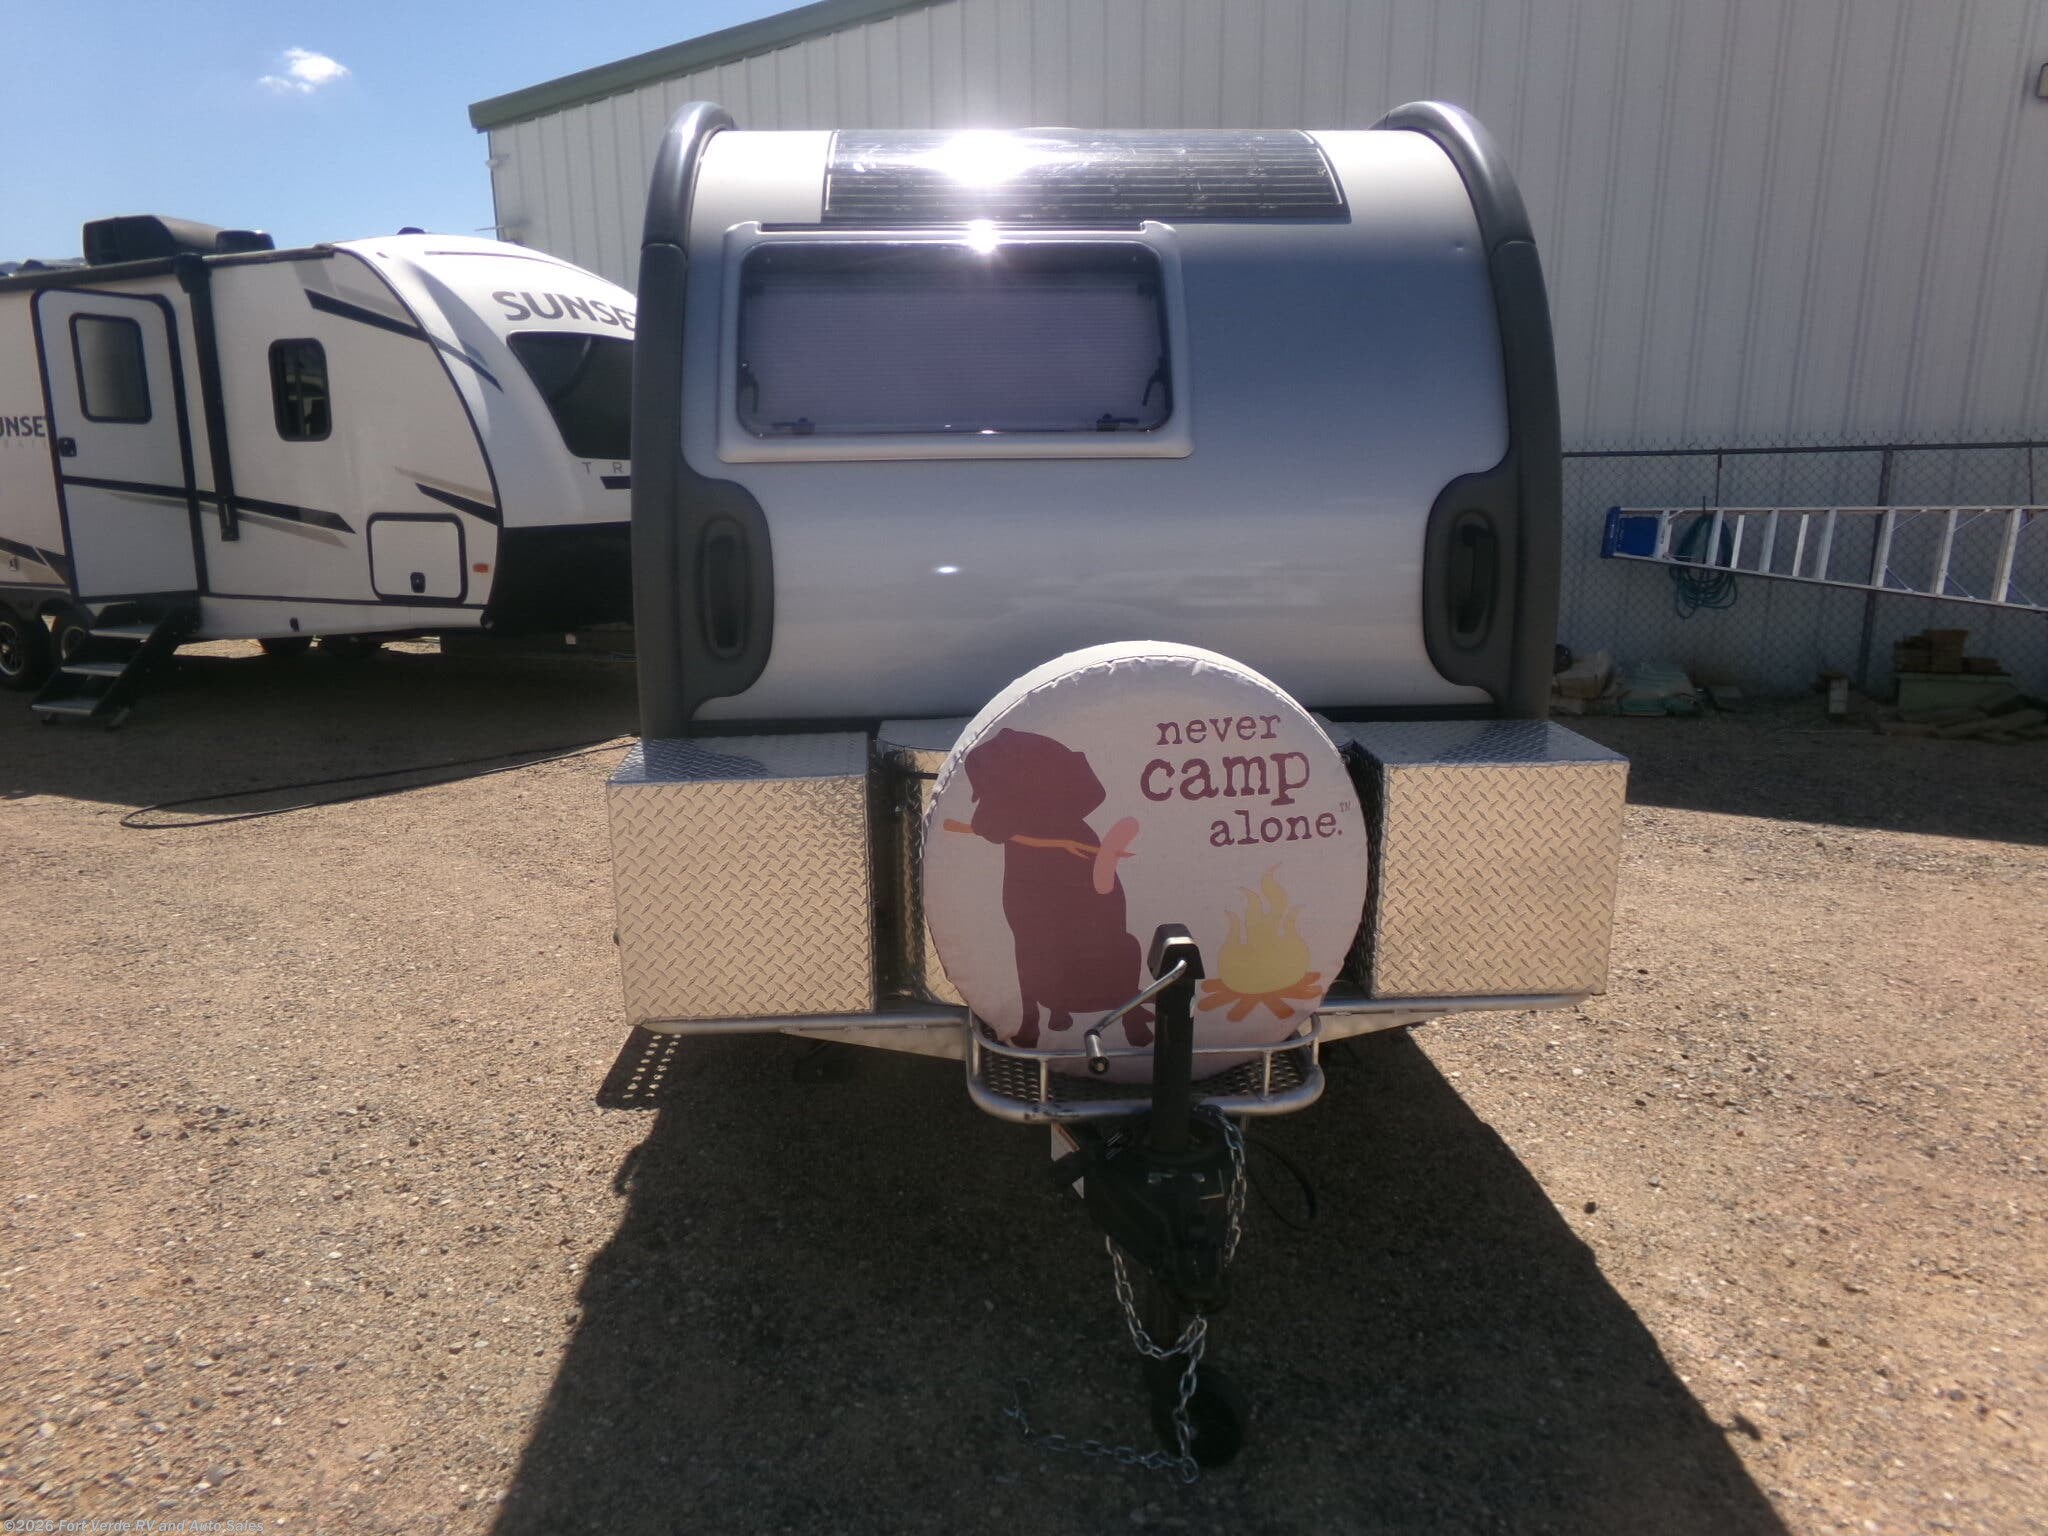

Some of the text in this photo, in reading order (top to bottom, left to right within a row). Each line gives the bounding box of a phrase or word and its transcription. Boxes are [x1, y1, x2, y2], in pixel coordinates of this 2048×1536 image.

[1156, 714, 1280, 746] never
[1140, 752, 1310, 806] camp
[1209, 809, 1343, 847] alone.
